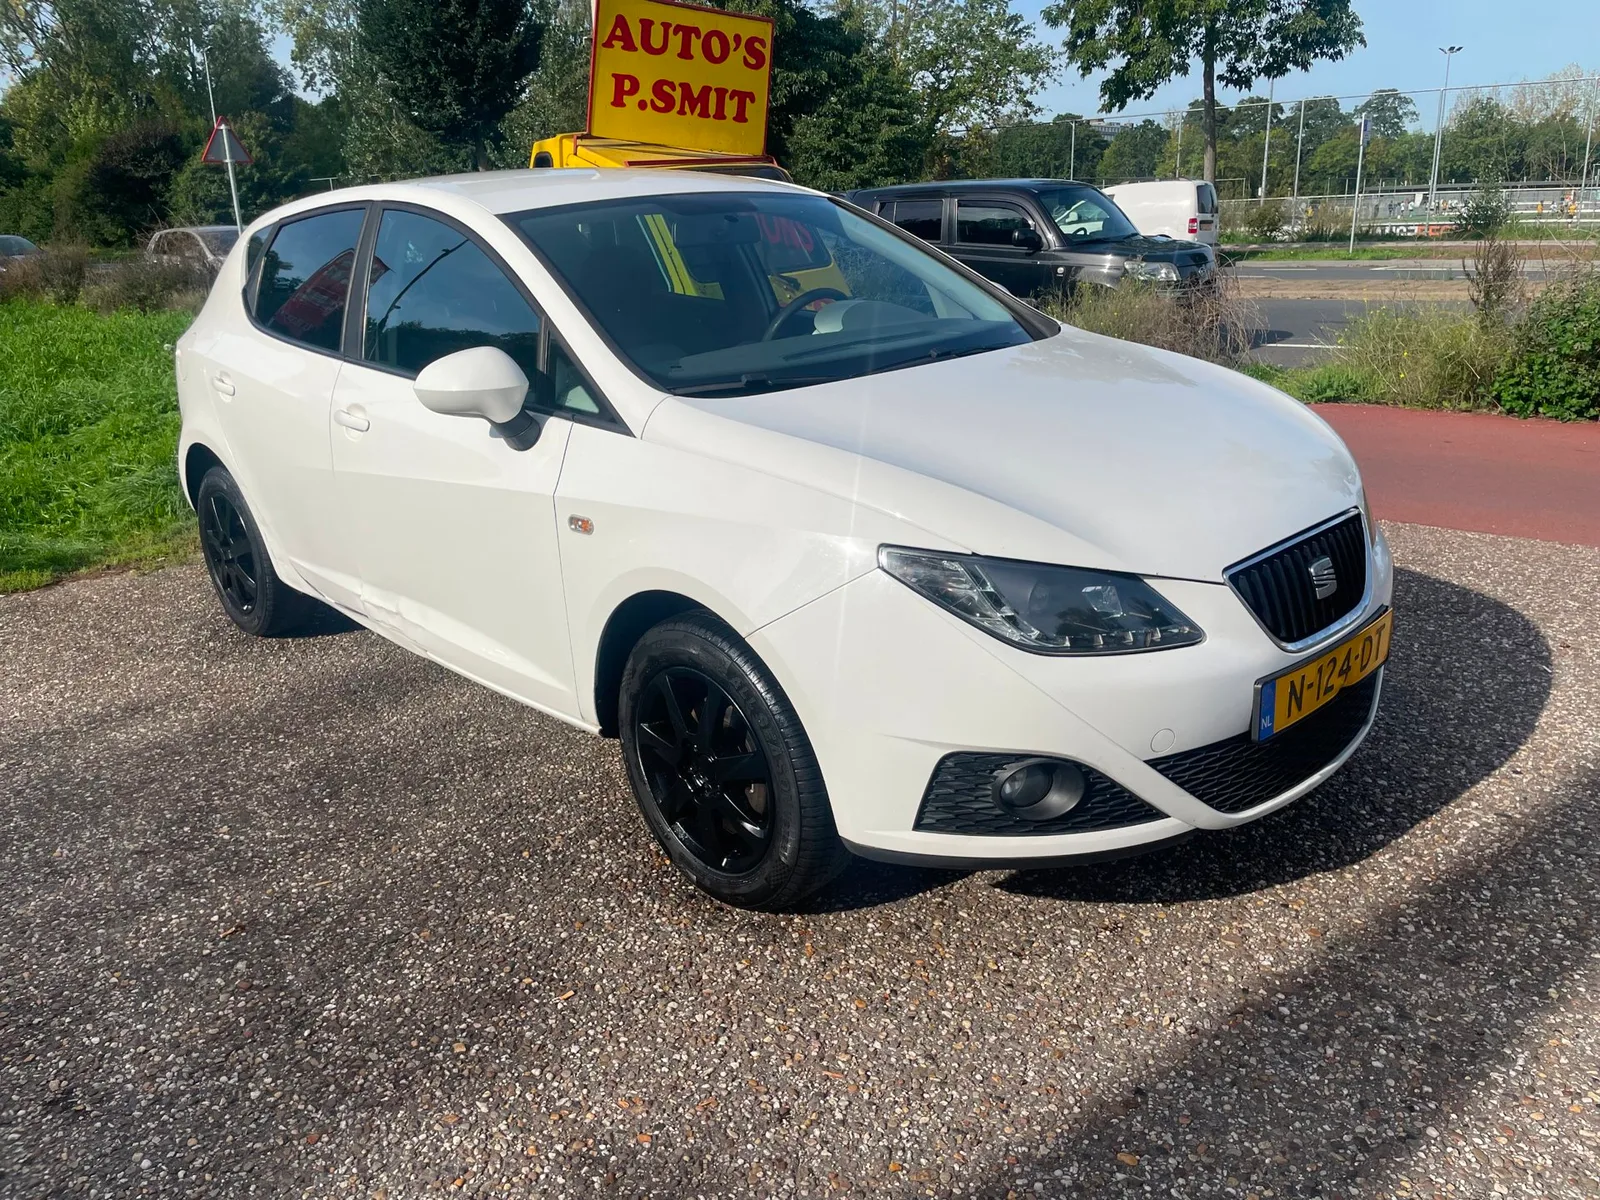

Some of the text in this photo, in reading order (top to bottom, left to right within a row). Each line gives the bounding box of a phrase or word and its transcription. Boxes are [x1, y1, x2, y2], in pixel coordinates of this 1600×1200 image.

[602, 14, 766, 70] AUTO'S
[610, 73, 756, 123] P.SMIT
[1287, 623, 1385, 718] N-124-DT
[1261, 715, 1272, 730] NL
